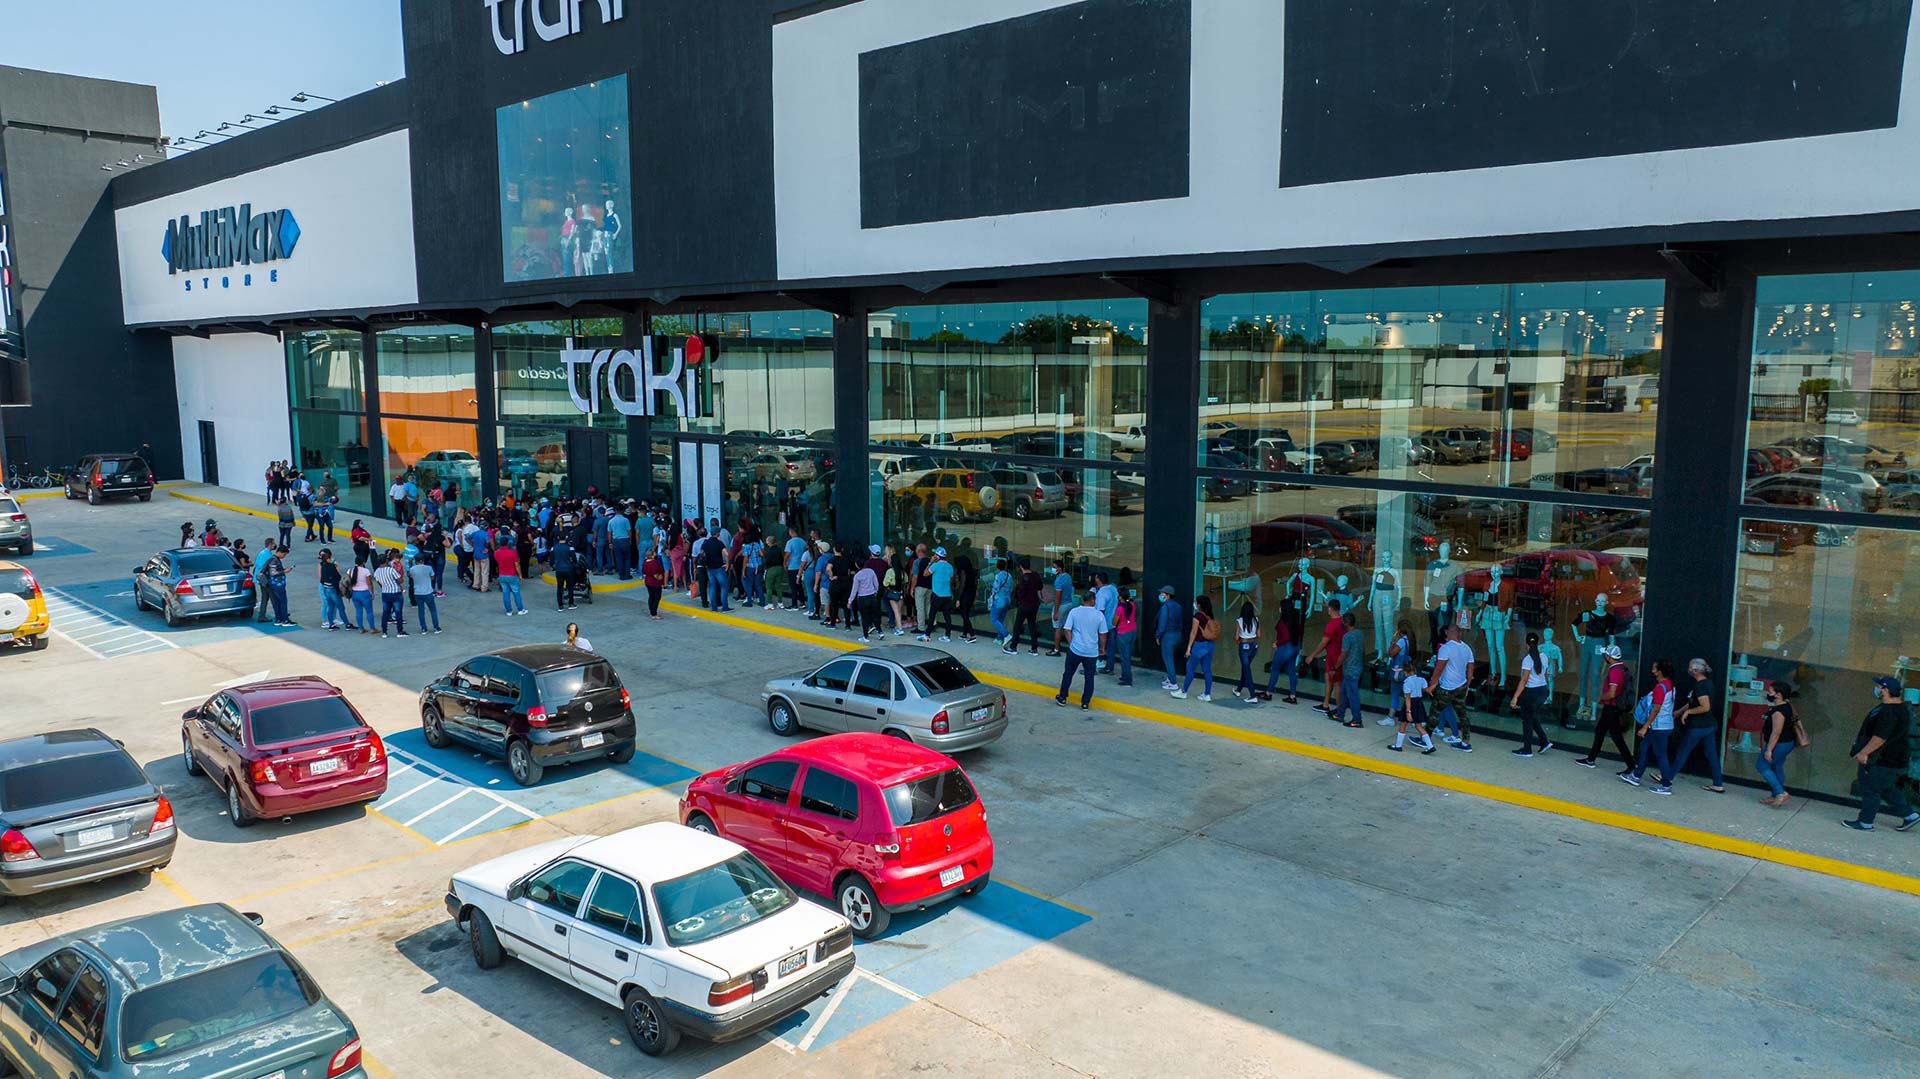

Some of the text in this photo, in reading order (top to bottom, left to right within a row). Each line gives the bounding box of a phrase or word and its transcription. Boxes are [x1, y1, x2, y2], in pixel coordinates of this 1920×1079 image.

[168, 203, 286, 275] MultiMax
[185, 269, 278, 291] STORE
[560, 334, 705, 418] traki
